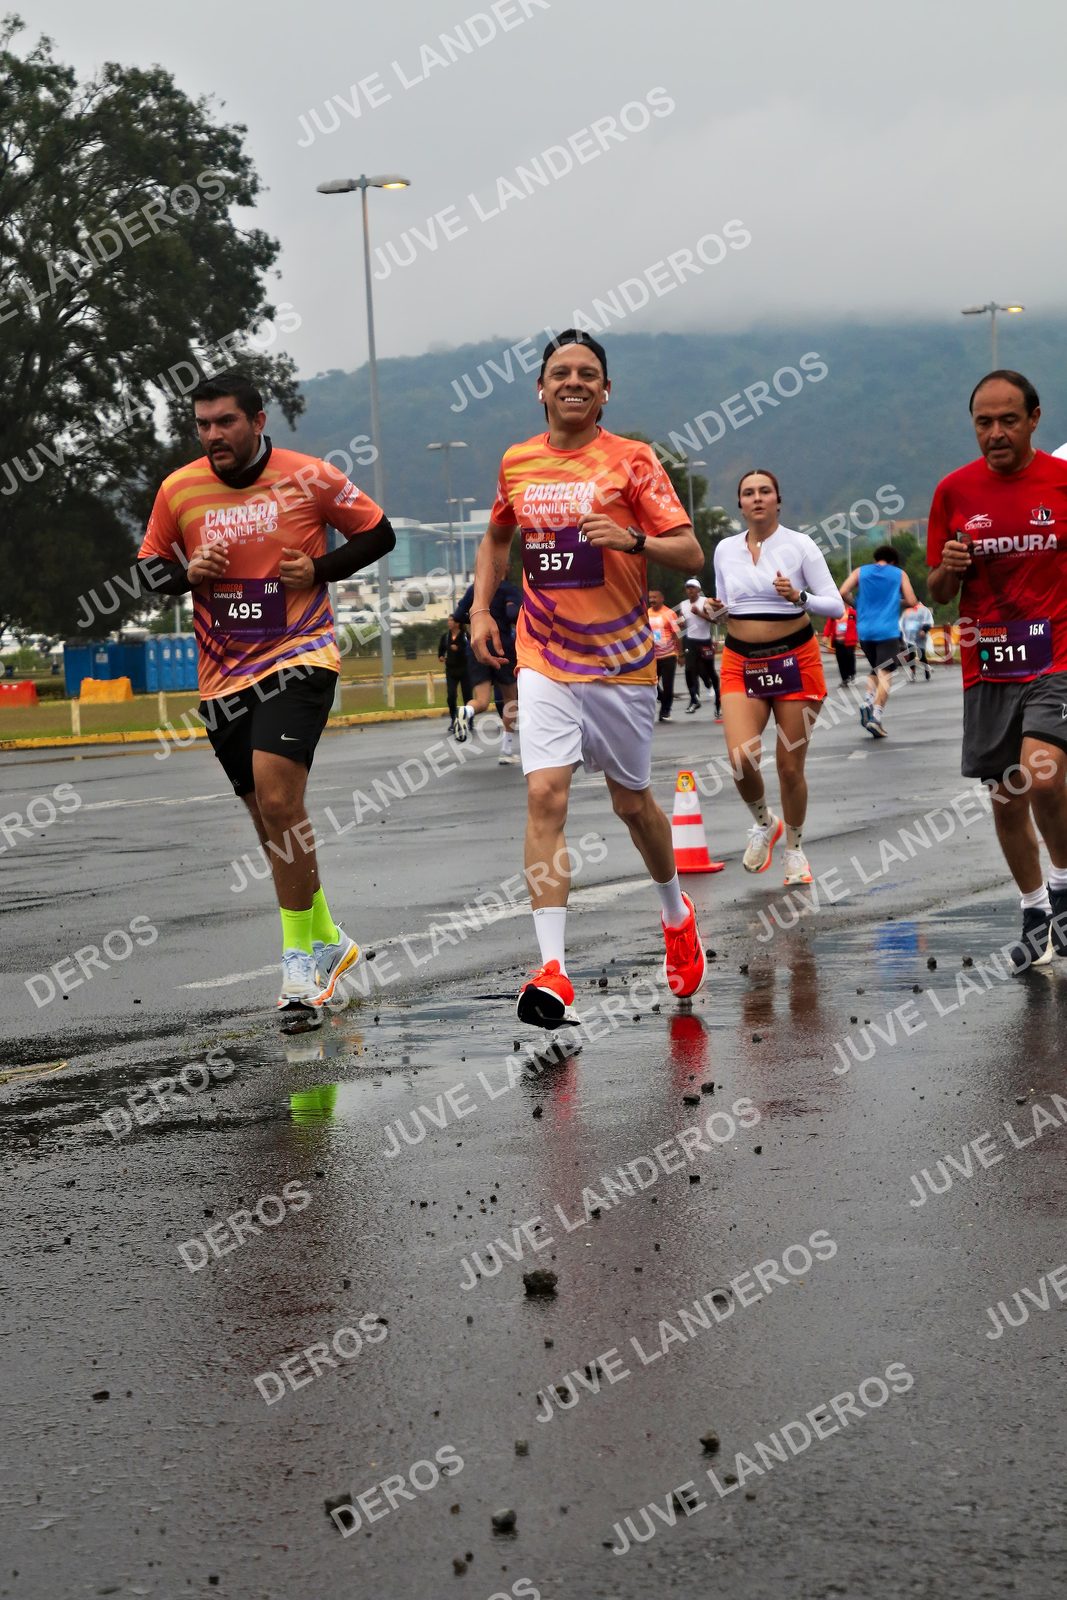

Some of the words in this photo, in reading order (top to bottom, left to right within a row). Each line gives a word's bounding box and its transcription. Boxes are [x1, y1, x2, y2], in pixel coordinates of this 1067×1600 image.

[523, 482, 595, 501] CARRERA
[205, 501, 278, 528] CARRERA
[973, 533, 1058, 556] ERDURA
[539, 552, 574, 571] 357
[214, 583, 243, 592] CARRERA
[228, 602, 262, 619] 495
[994, 645, 1027, 662] 511
[757, 673, 783, 686] 134
